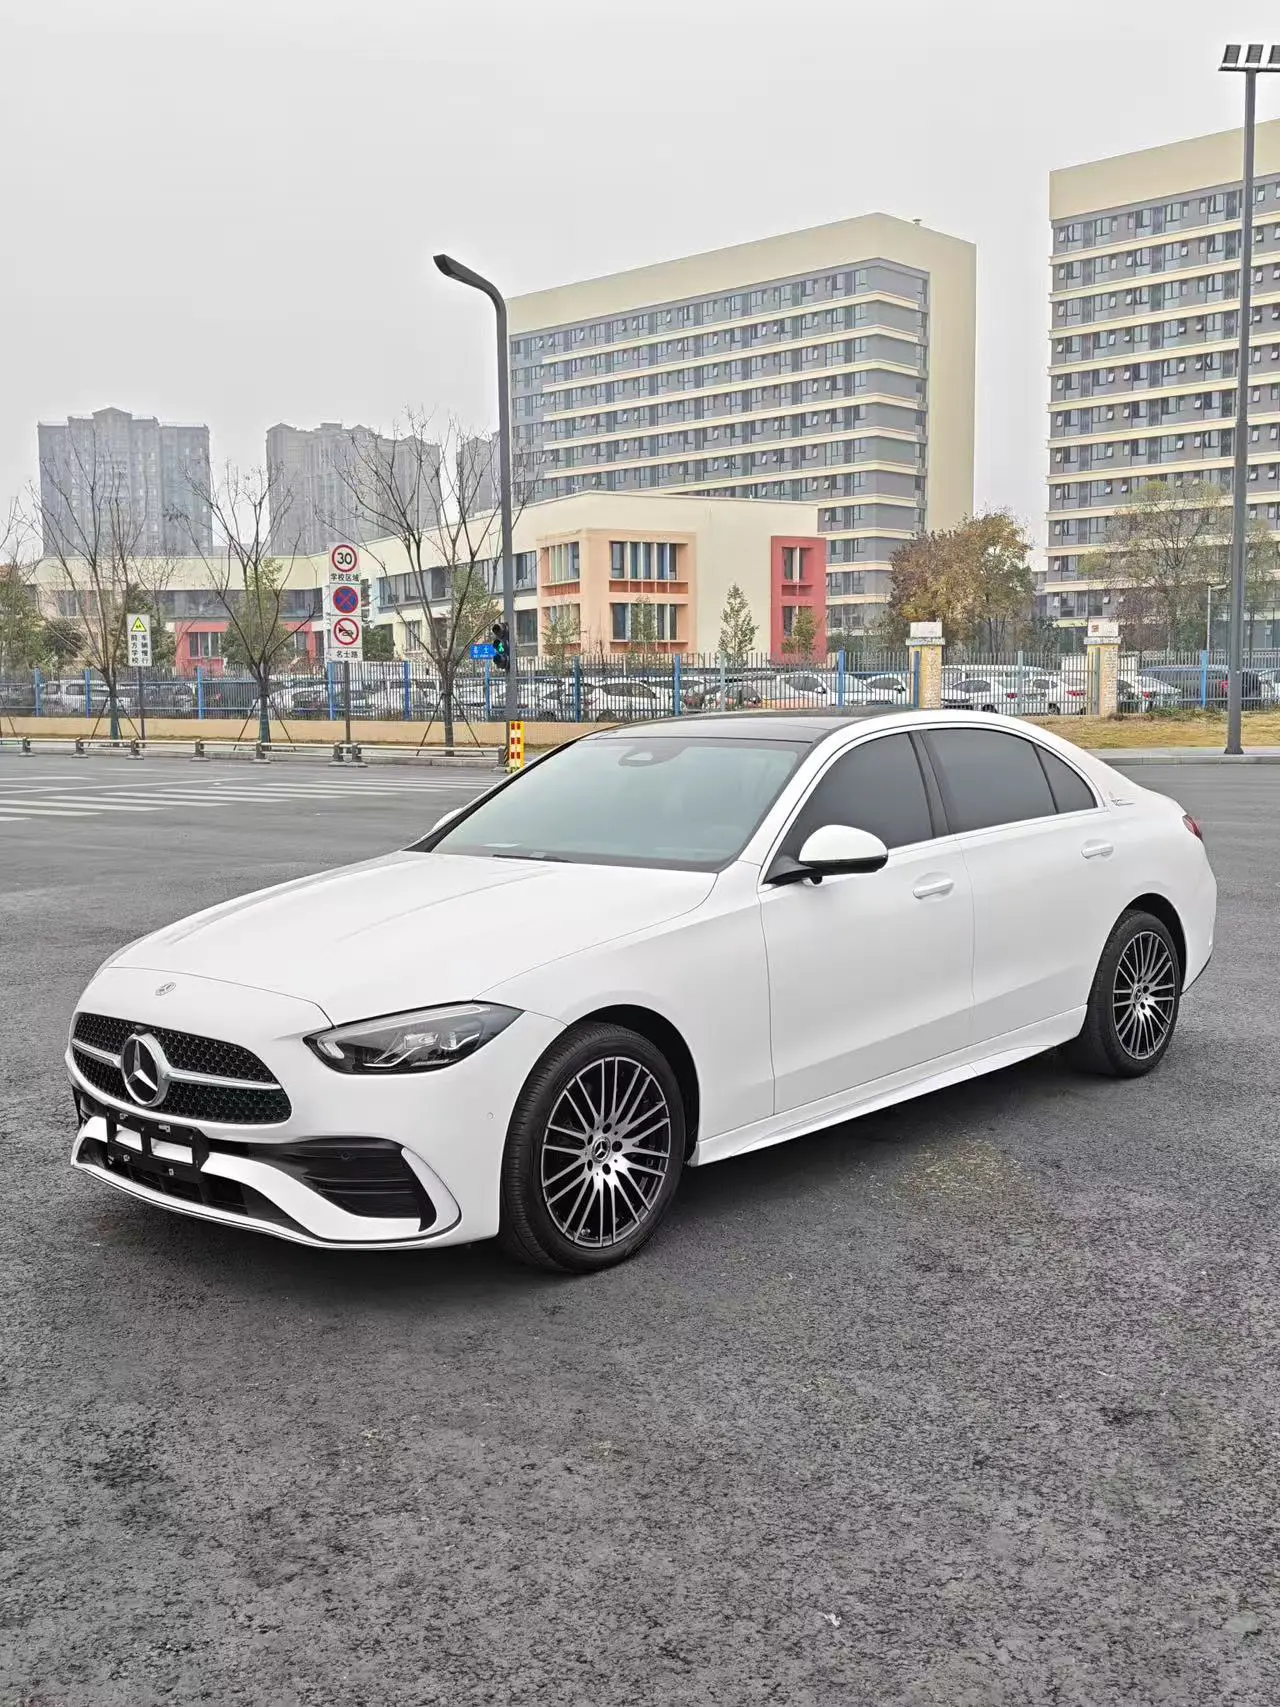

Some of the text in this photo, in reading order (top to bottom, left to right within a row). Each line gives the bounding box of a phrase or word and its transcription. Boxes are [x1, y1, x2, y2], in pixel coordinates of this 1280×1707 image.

[337, 552, 353, 565] 30
[330, 573, 360, 582] 学校区域
[141, 634, 149, 664] 车辆慢行
[336, 650, 359, 659] 名士路
